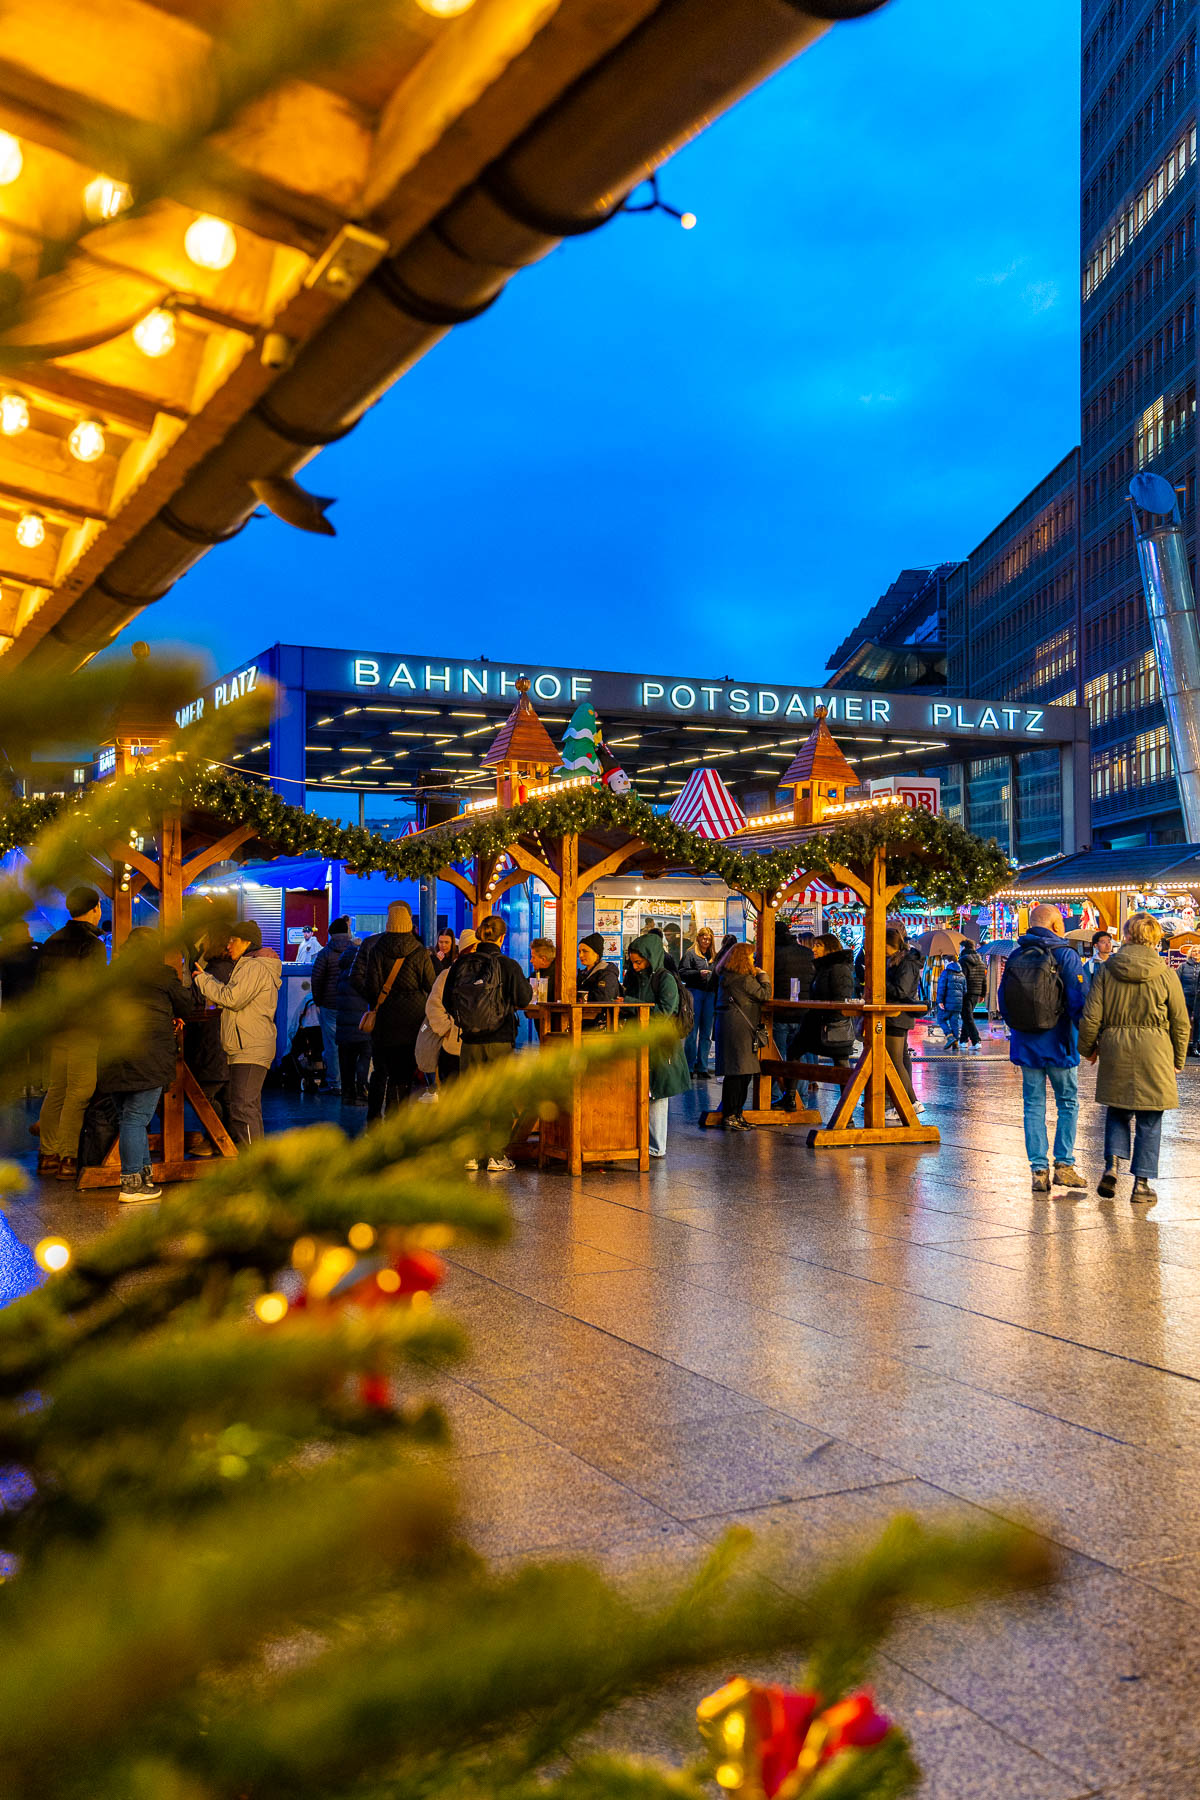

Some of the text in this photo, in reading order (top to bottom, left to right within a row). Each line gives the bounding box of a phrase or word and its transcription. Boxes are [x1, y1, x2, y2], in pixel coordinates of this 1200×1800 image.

[214, 665, 258, 710] PLATZ
[354, 659, 1044, 732] BAHNHOF POTSDAMER PLATZ
[902, 791, 933, 813] DB
